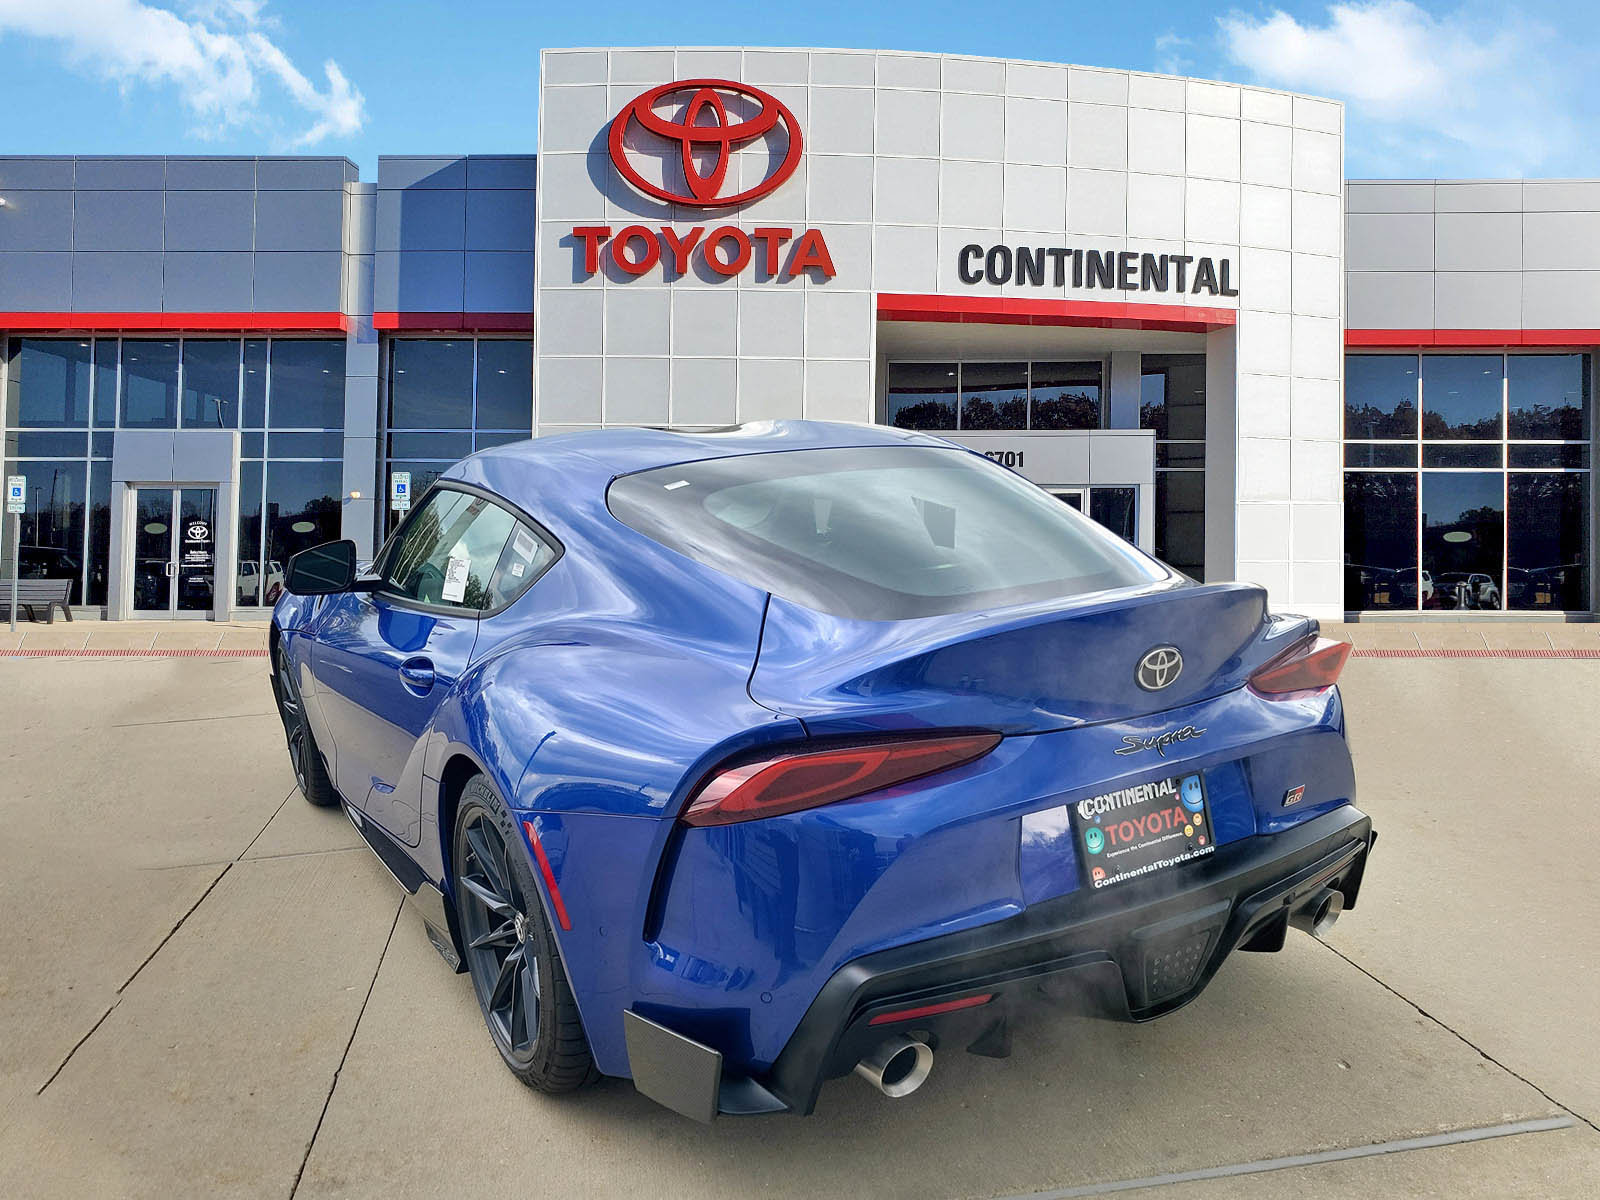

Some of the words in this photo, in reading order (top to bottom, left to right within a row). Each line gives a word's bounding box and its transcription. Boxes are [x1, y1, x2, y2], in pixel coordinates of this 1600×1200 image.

[572, 225, 837, 277] TOYOTA
[958, 244, 1239, 297] CONTINENTAL
[1114, 725, 1208, 758] Supra
[1077, 778, 1177, 820] CONTINENTAL
[1104, 806, 1188, 846] TOYOTA
[1094, 845, 1215, 889] ContinentalToyota.com
[1106, 847, 1130, 858] Experience
[1138, 838, 1161, 849] Continental
